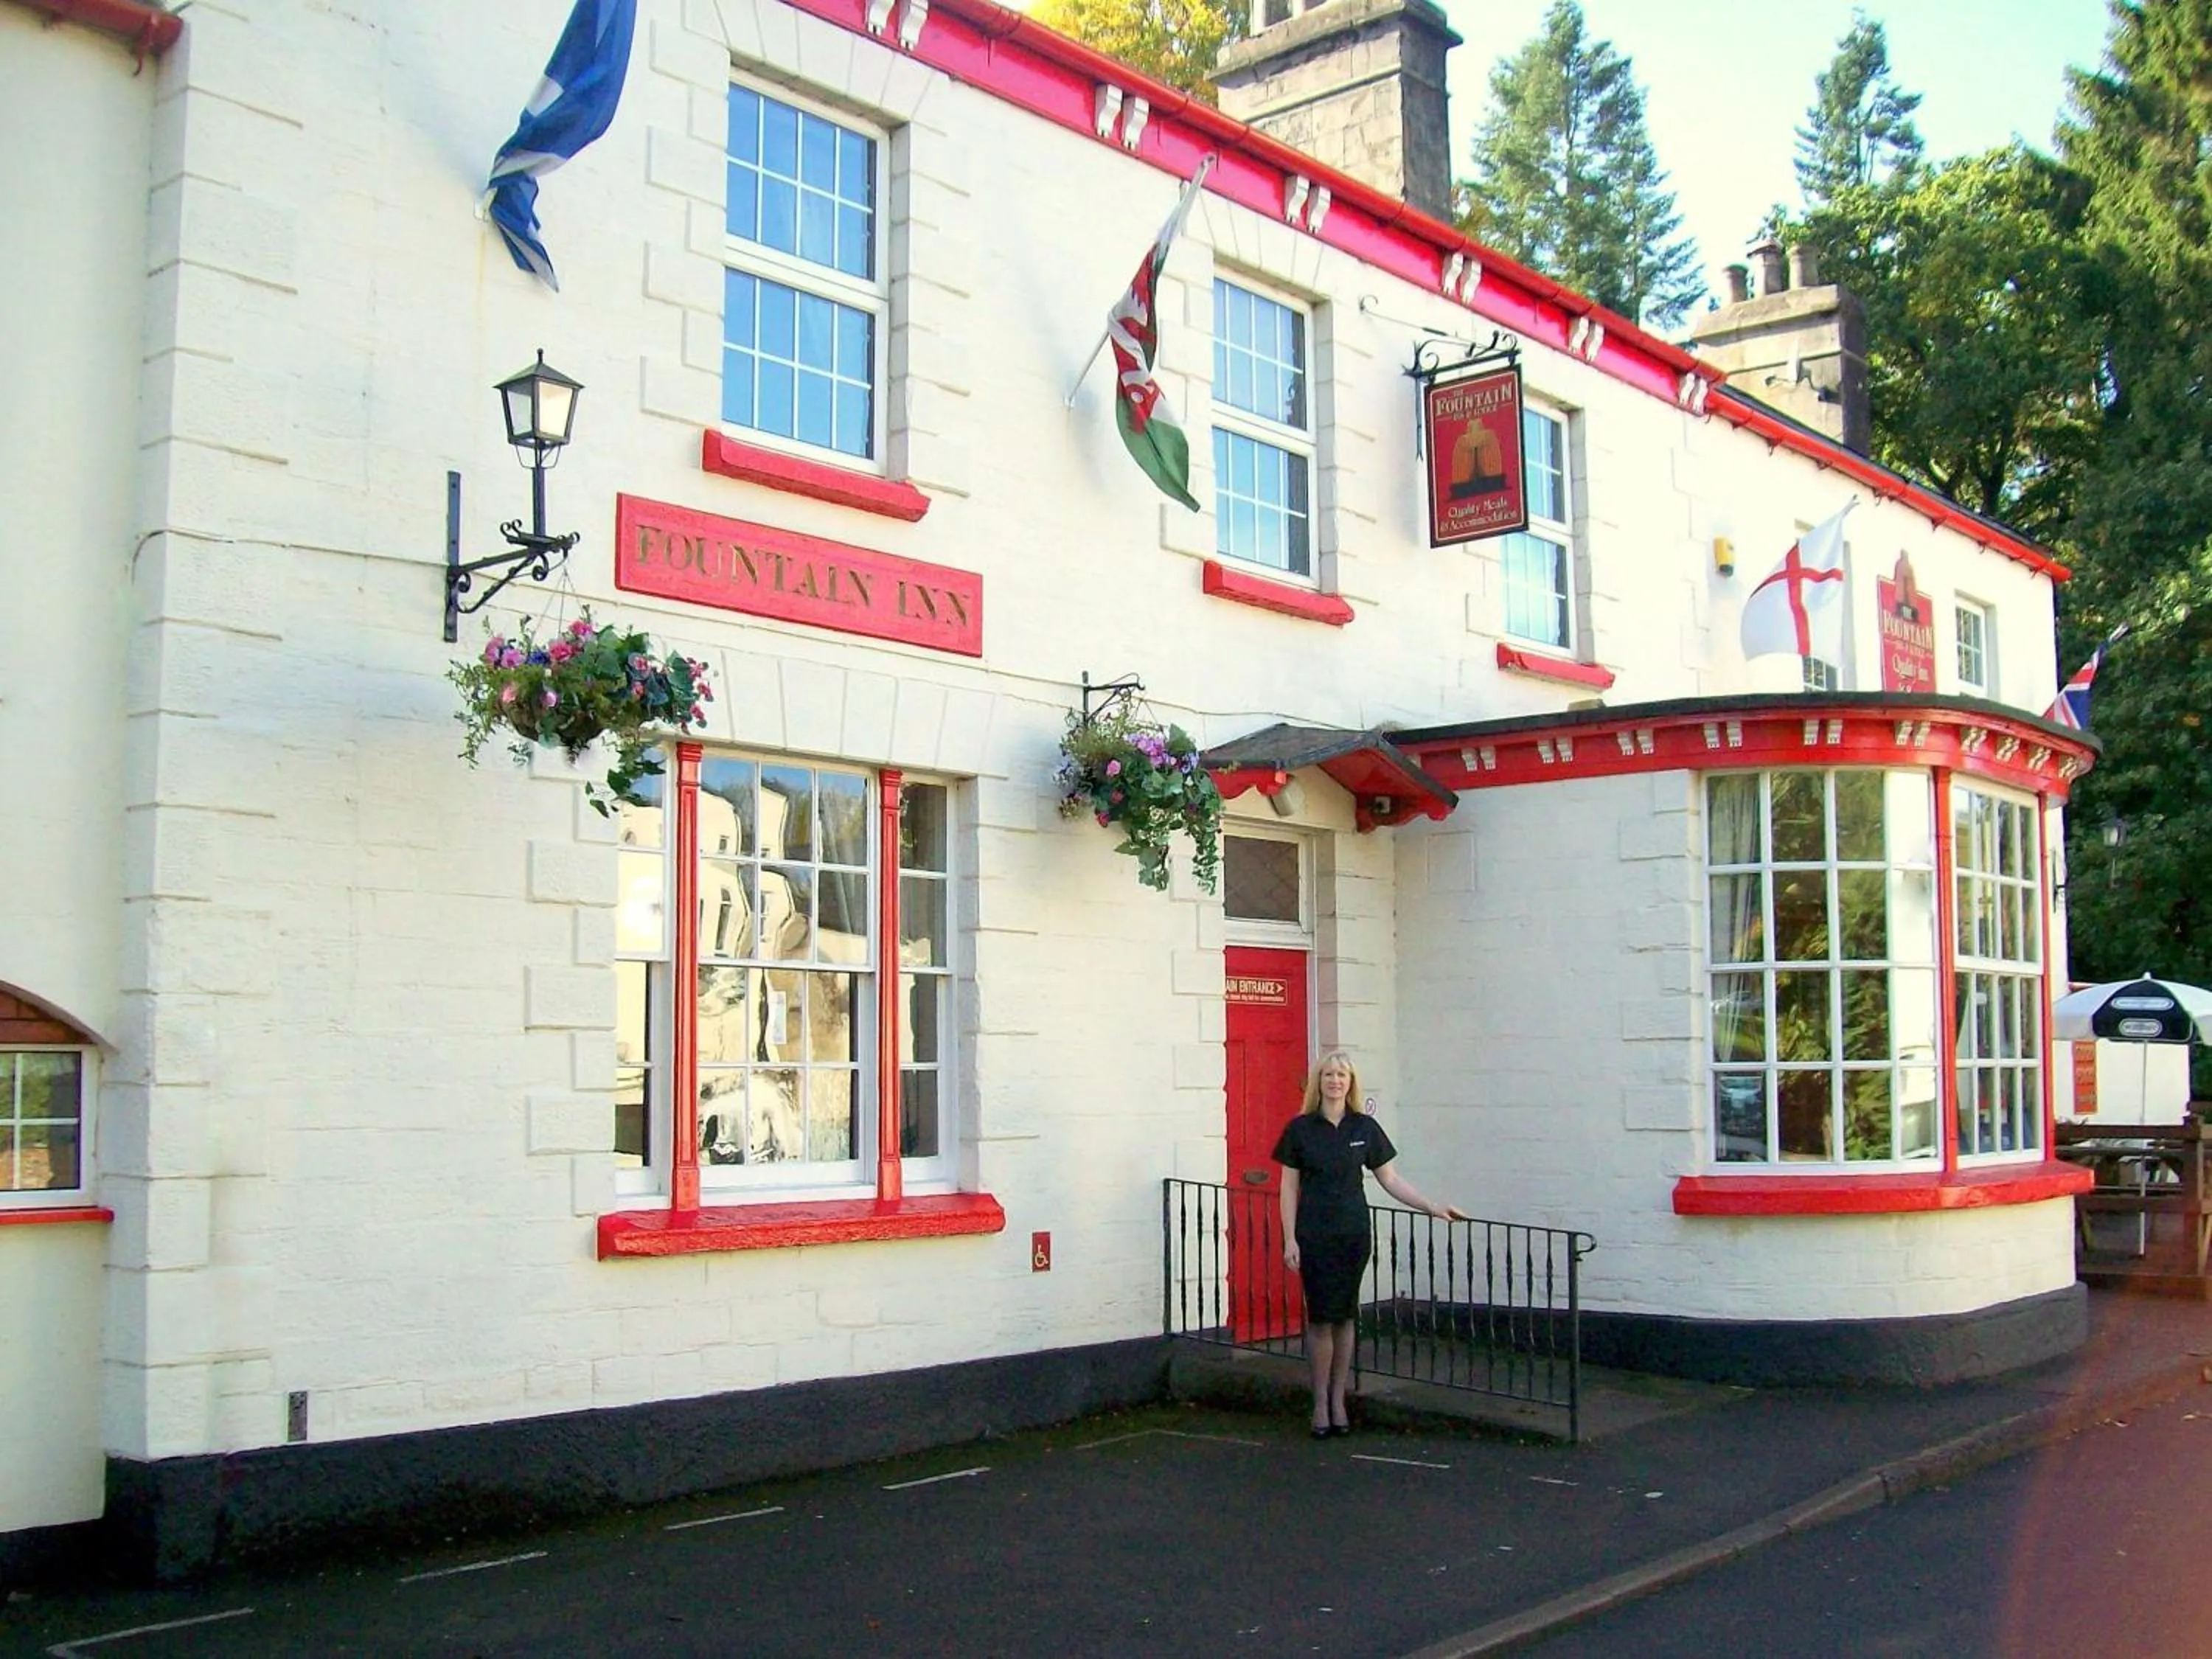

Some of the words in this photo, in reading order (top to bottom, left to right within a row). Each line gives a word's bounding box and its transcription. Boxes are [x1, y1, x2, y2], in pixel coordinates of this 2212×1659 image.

[1436, 382, 1512, 416] FOUNTAIN
[1448, 503, 1481, 519] Quality
[1483, 495, 1507, 511] Meals
[636, 525, 874, 607] FOUNTAIN
[897, 580, 971, 627] INN
[1883, 609, 1933, 650] FOUNTAIN
[1239, 981, 1275, 994] ENTRANCE
